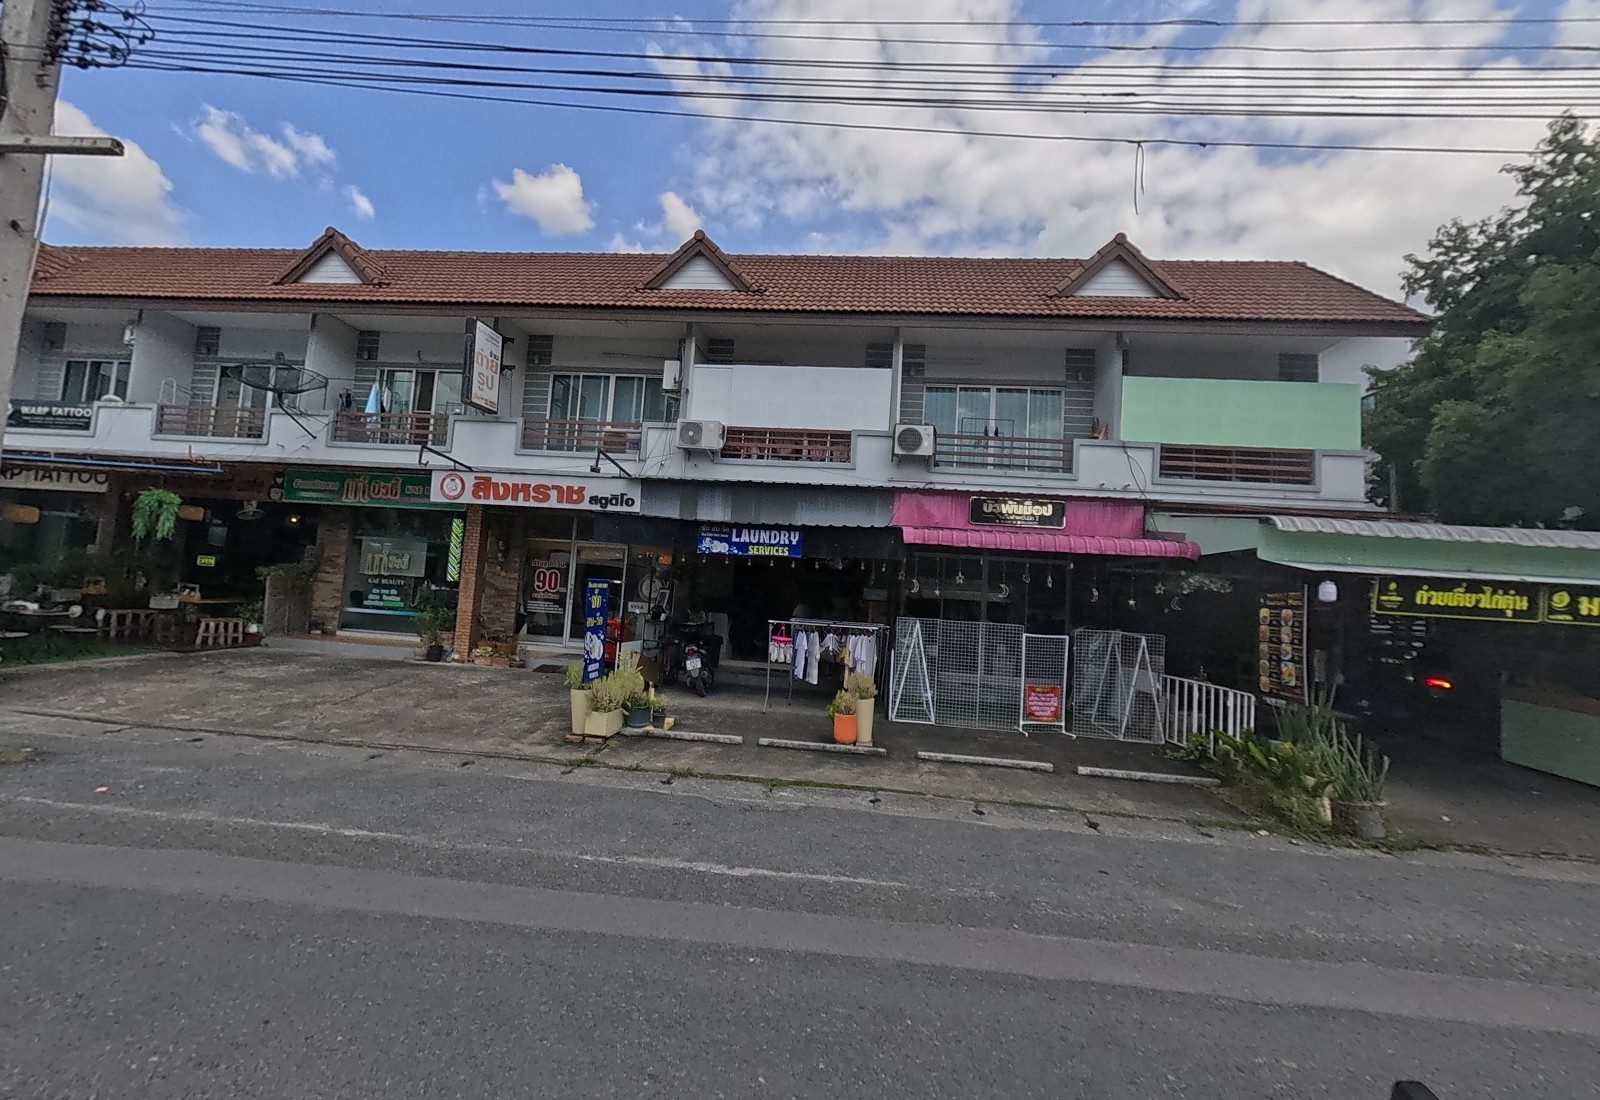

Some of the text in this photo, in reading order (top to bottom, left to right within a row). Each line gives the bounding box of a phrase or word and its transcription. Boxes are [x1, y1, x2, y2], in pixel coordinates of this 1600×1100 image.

[51, 406, 92, 417] TATTOO
[471, 475, 586, 505] สิงหราช
[731, 528, 800, 545] LAUNDRY
[748, 545, 789, 556] SERVICES
[534, 568, 560, 592] 90
